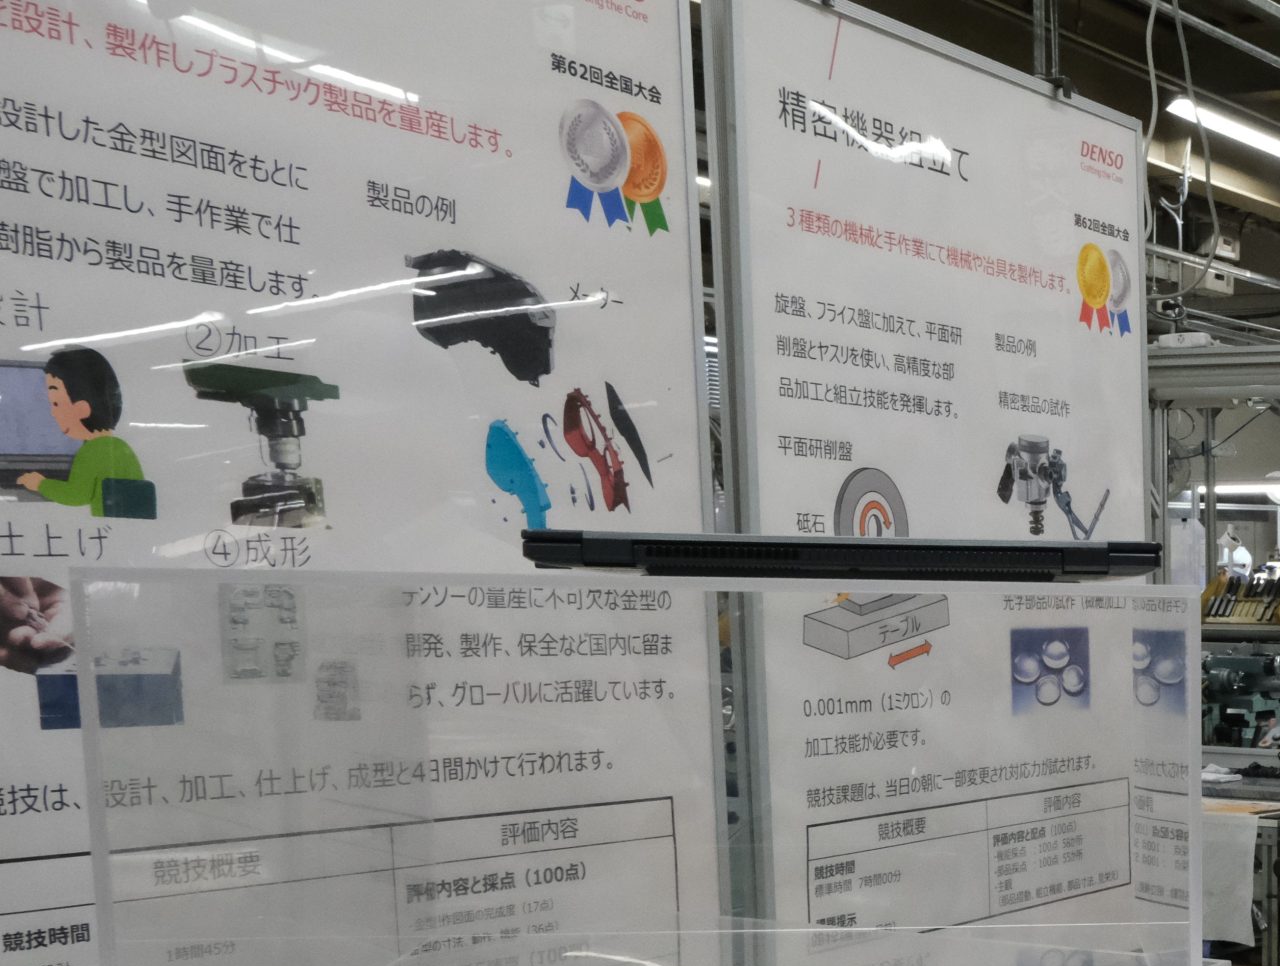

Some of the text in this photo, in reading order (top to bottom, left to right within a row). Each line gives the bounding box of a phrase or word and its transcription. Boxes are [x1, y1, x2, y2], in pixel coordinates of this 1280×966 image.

[625, 5, 648, 23] Core
[550, 53, 662, 105] 第62回全国大会
[0, 98, 309, 190] 設計した金型図面をもとに
[1080, 140, 1124, 170] DENSO
[0, 159, 301, 245] 盤で加工し、手作業で仕
[366, 180, 457, 224] 製品の例
[1074, 213, 1130, 242] 第62回全国大会
[774, 291, 963, 346] 旋盤、フライス盤に加えて、平面研
[775, 334, 955, 382] 削盤とヤスリを使い、高精度な部
[994, 331, 1038, 358] 製品の例
[778, 376, 959, 420] 品加工と組立技能を発揮します。
[998, 390, 1071, 419] 精密製品の試作
[777, 434, 853, 462] 平面研削盤
[796, 512, 825, 534] 砥石
[878, 616, 922, 644] テーブル
[408, 676, 675, 709] らず、グローバルに活躍しています。
[804, 727, 927, 758] 加工技能が必要です。
[501, 817, 580, 847] 評価内容
[877, 816, 927, 841] 競技概要
[152, 850, 263, 887] 競技概要
[814, 860, 855, 881] 競技時間
[814, 878, 853, 898] 標準時間
[2, 922, 91, 953] 競技時間
